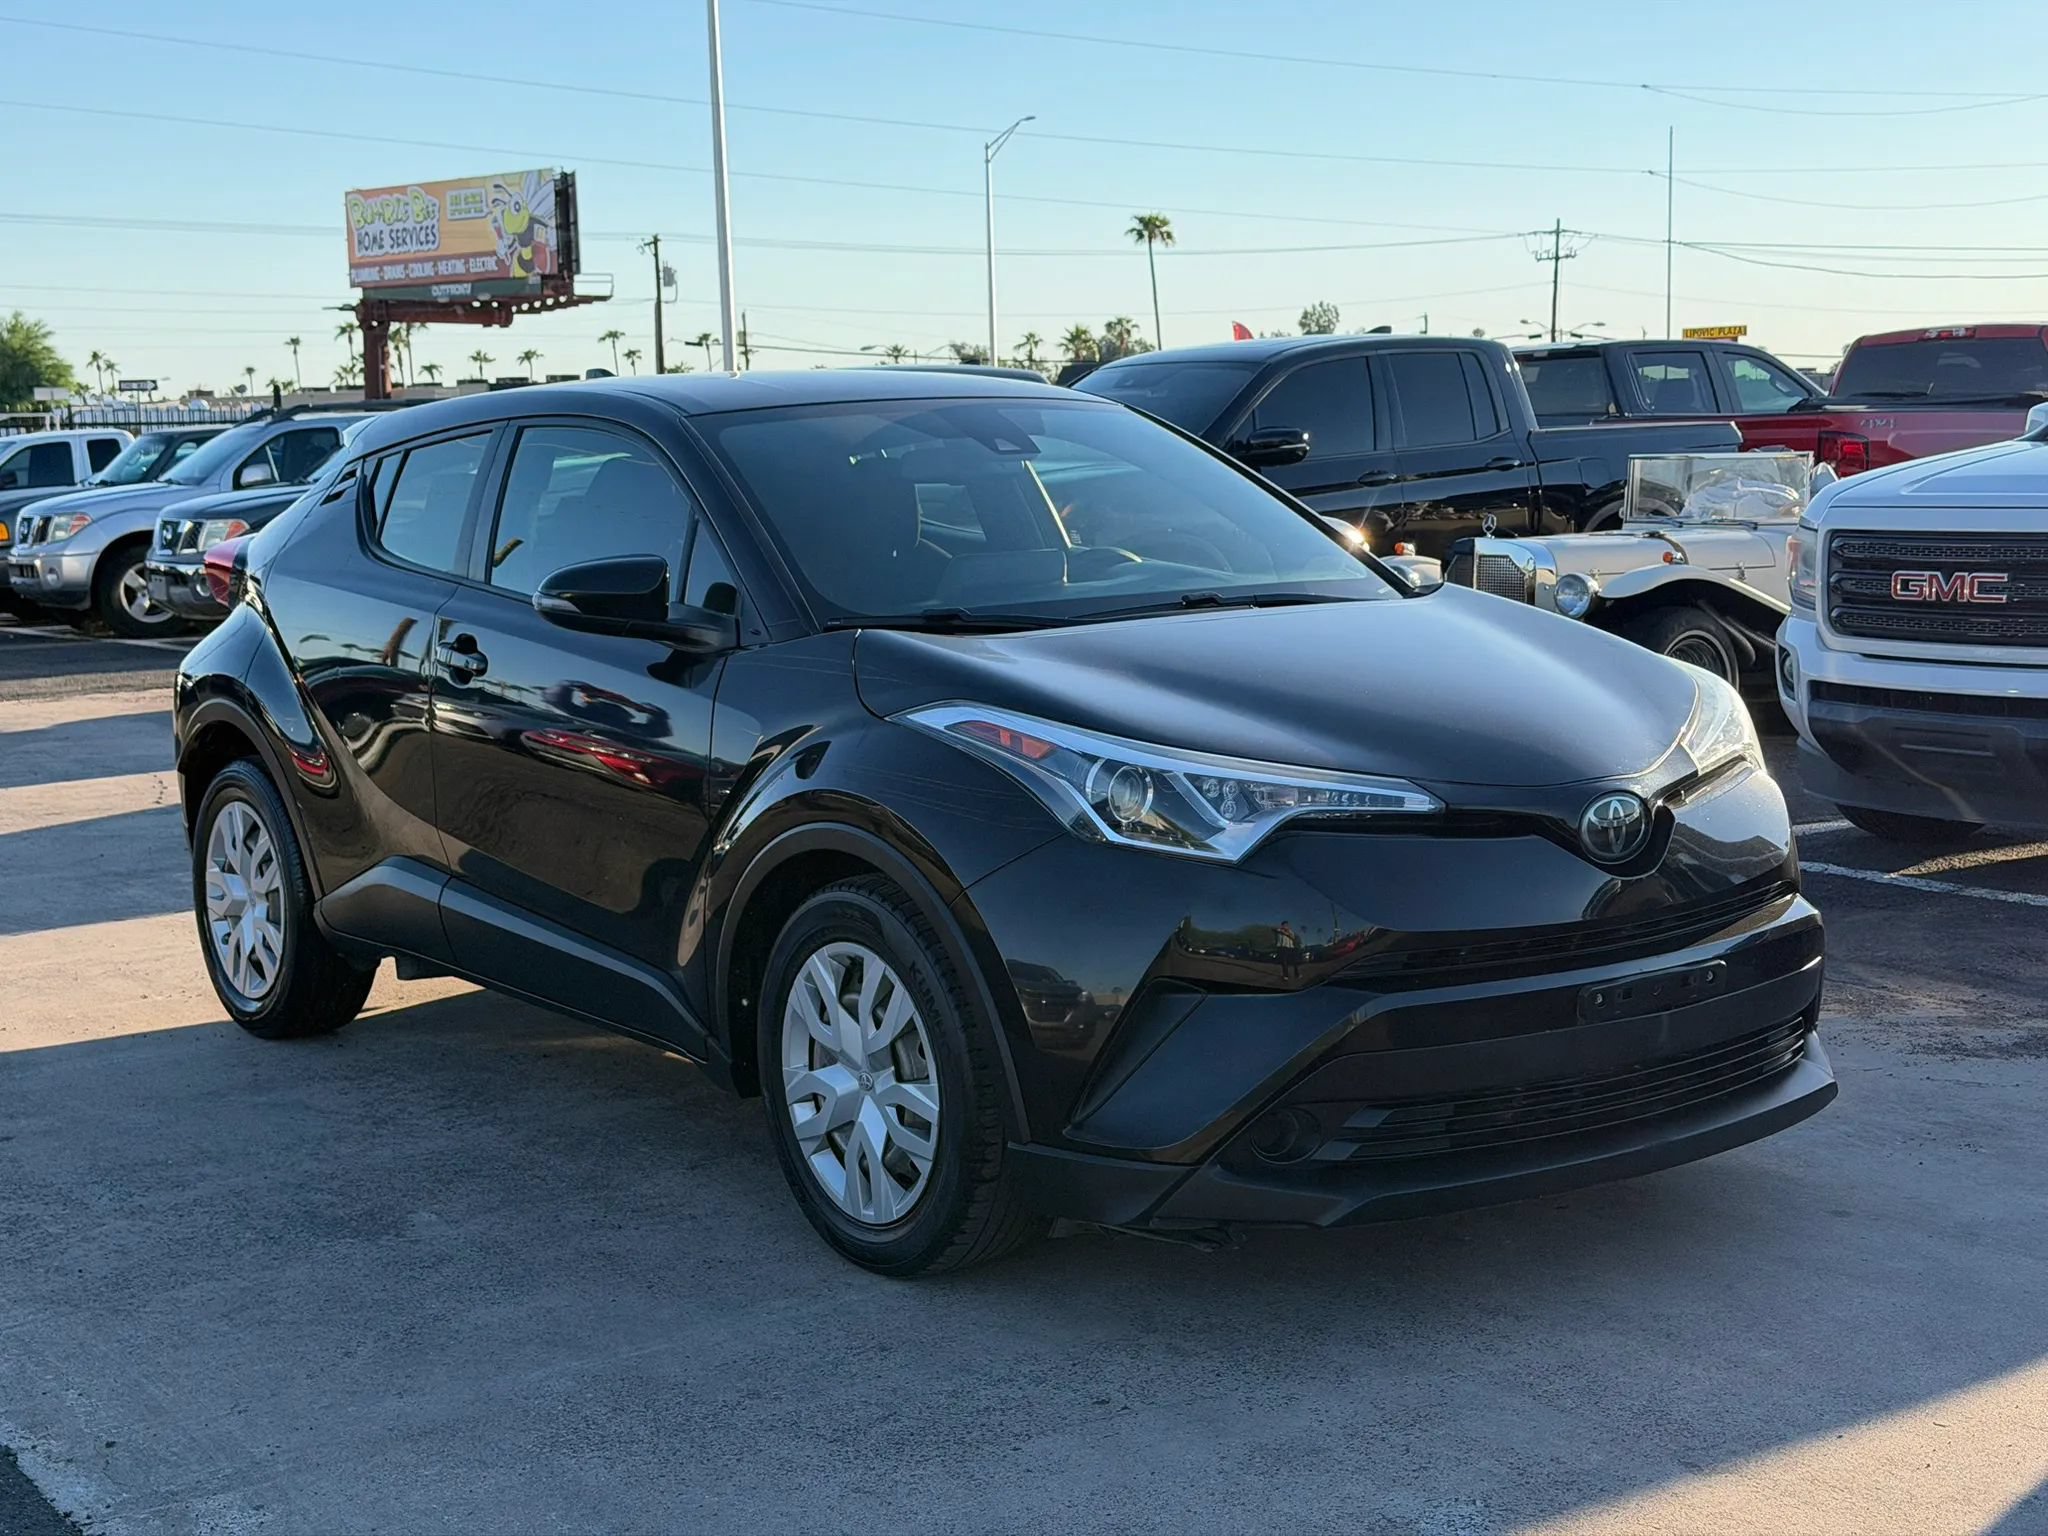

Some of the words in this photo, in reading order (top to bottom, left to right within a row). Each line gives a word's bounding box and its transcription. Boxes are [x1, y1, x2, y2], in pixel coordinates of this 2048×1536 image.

[357, 230, 384, 253] HOME
[389, 224, 437, 249] SERVICES
[1685, 328, 1715, 338] LIPOVIC
[1718, 326, 1742, 336] PLAZA
[1891, 570, 2008, 603] GMC
